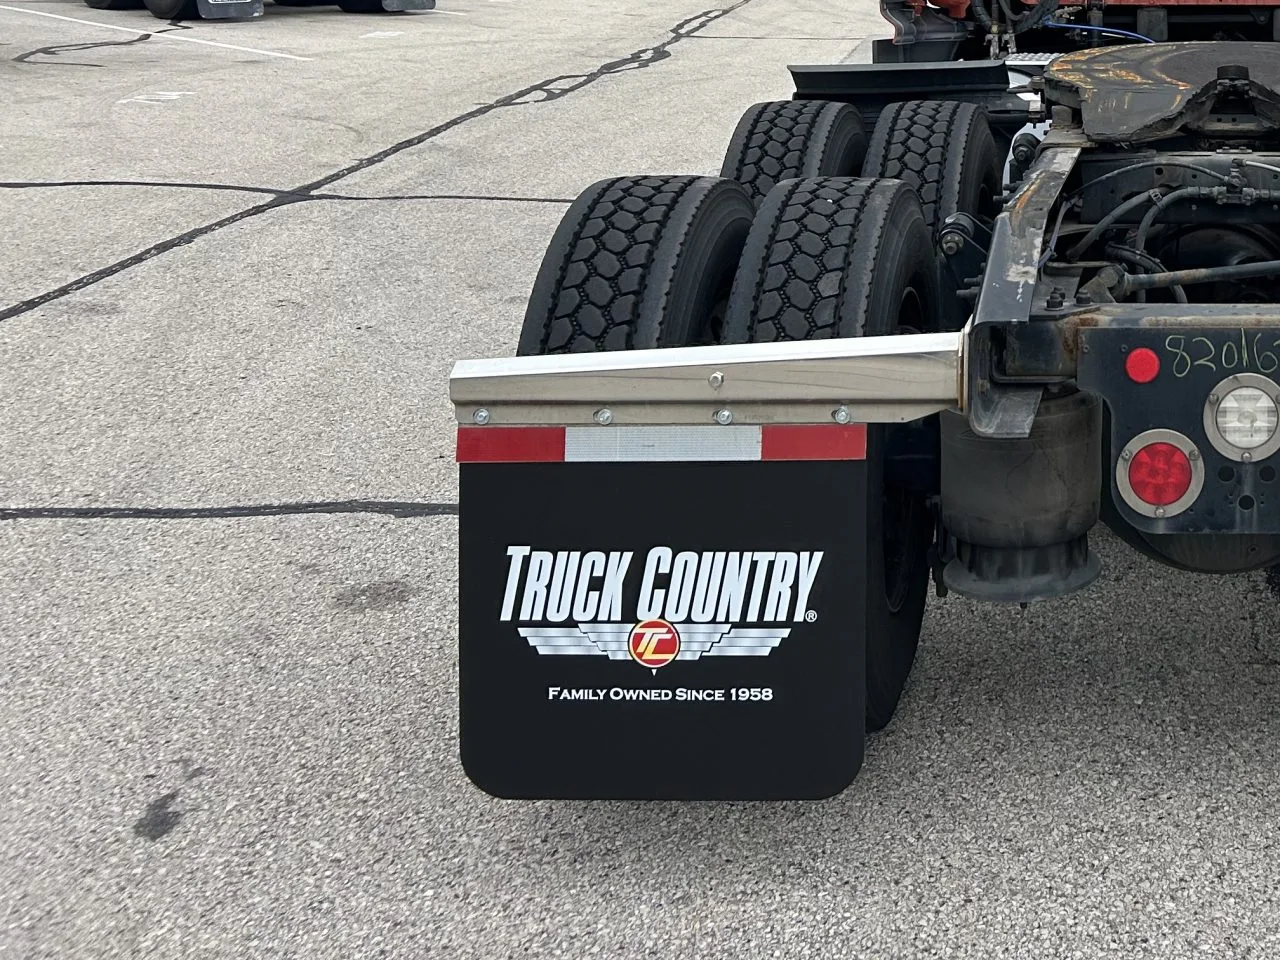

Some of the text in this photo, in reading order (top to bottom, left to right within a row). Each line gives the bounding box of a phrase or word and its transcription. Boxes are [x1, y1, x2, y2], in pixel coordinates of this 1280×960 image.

[500, 545, 634, 622] TRUCK
[548, 687, 773, 701] FAMILY OWNED SINCE 1958
